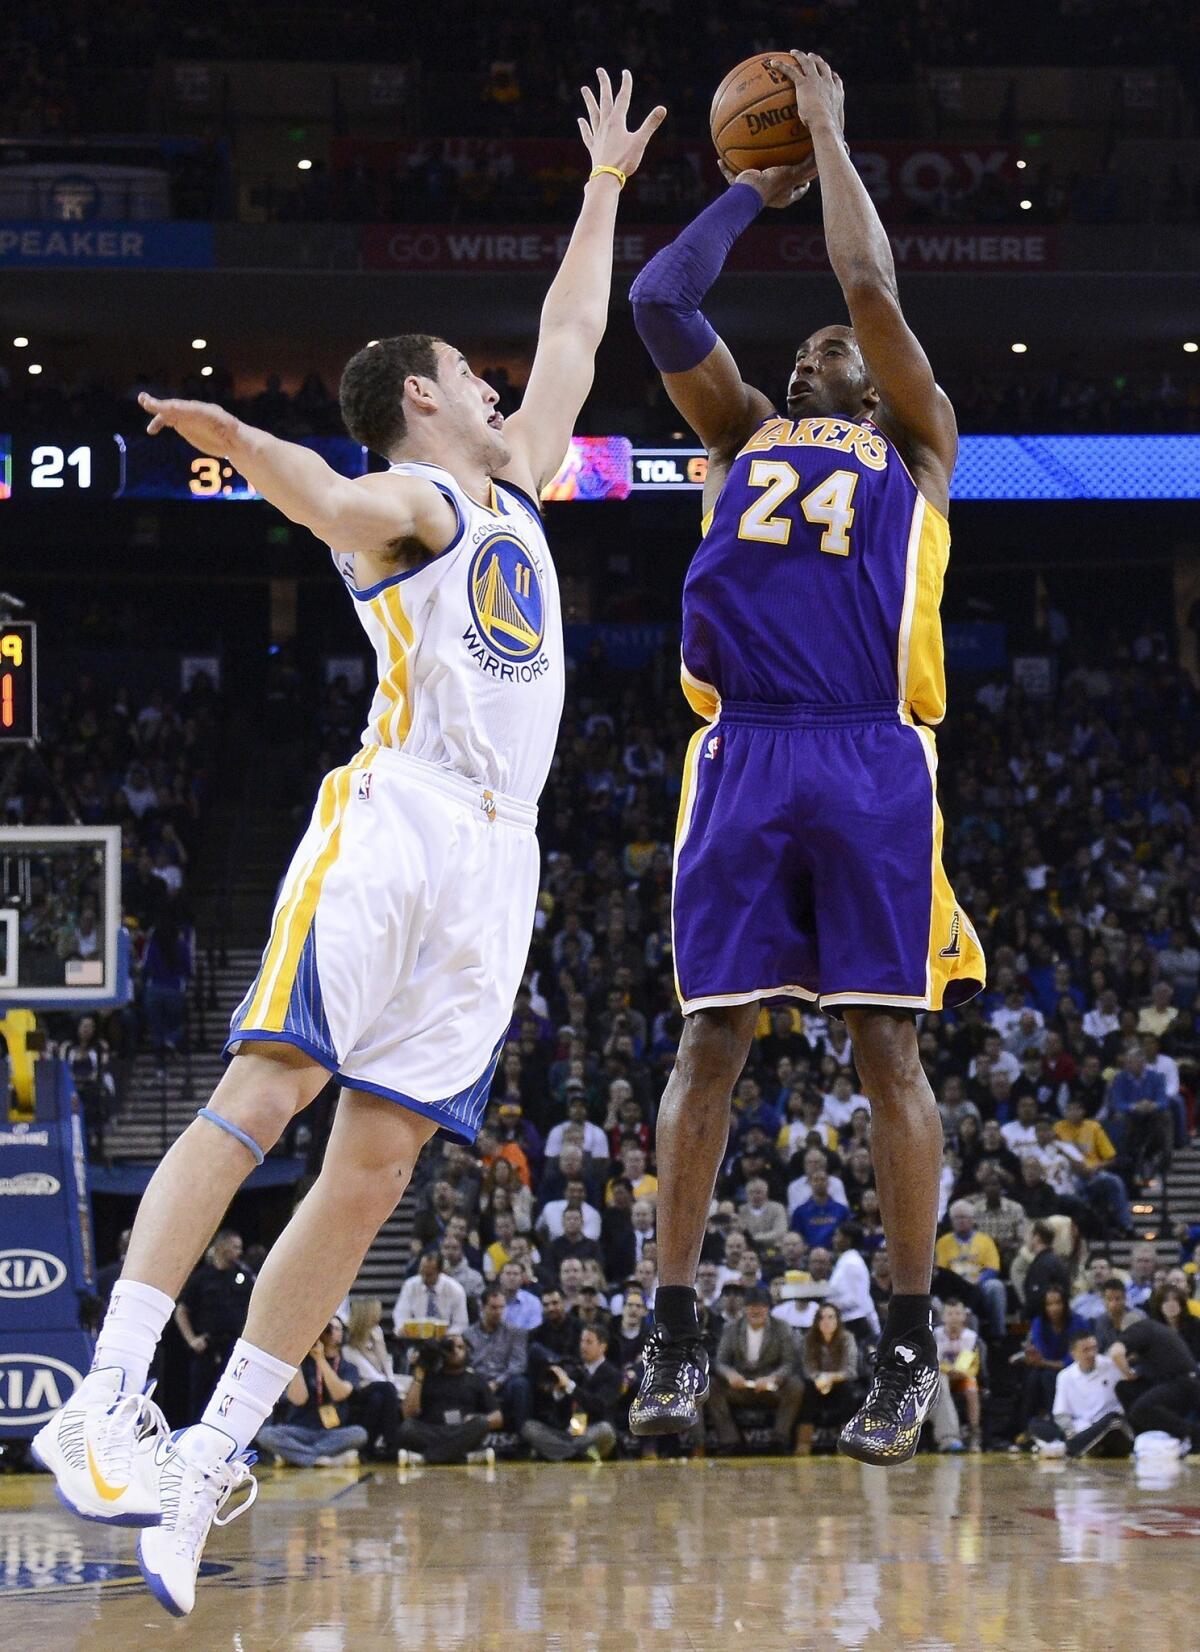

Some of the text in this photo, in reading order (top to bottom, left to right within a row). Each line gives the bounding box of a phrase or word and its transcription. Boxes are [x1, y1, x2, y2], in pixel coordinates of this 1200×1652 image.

[387, 234, 441, 262] GO
[890, 235, 1046, 262] YWHERE
[735, 417, 888, 471] LAKERS
[31, 445, 91, 488] 21
[636, 459, 684, 482] TOL
[738, 459, 859, 557] 24
[514, 562, 532, 600] 11
[462, 623, 551, 684] WARRIORS
